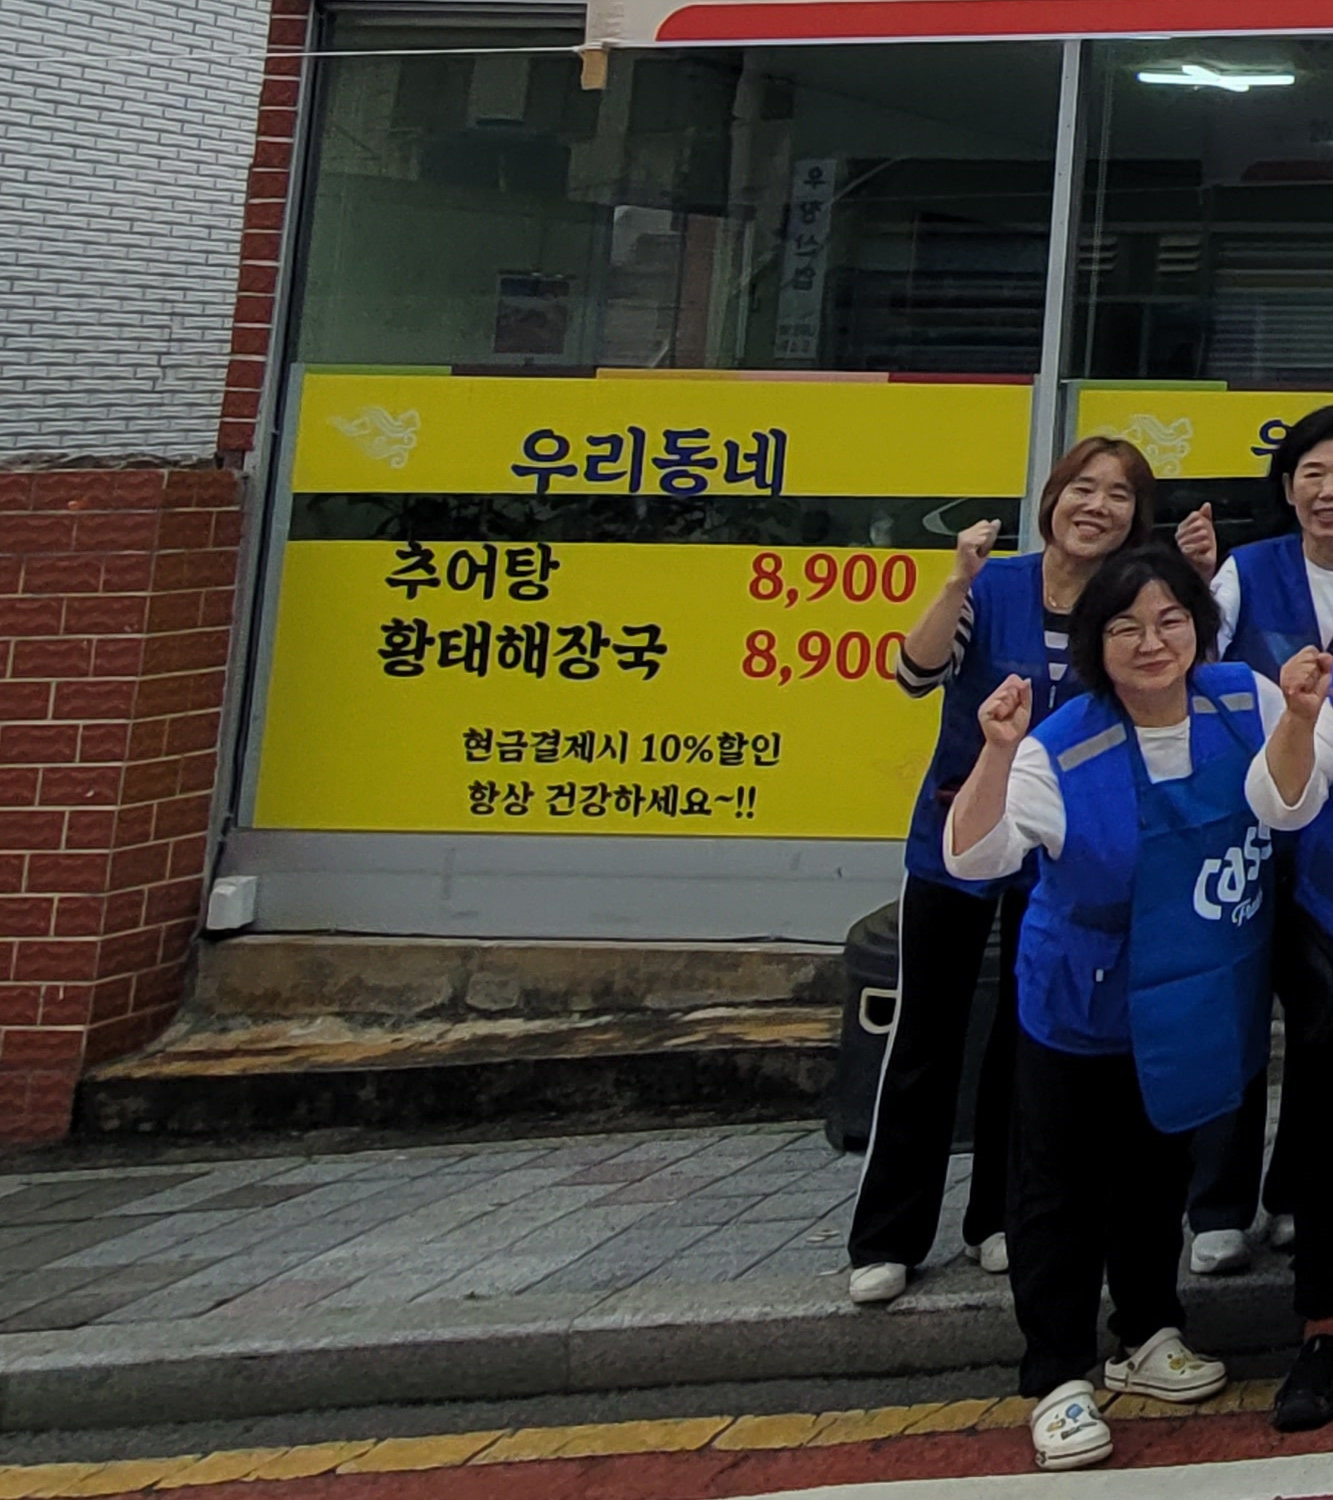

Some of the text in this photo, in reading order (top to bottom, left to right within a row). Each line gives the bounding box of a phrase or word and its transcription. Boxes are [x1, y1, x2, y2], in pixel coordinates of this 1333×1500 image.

[510, 424, 789, 497] 우리동네
[384, 541, 919, 609] 추어탕 8,900
[376, 617, 669, 682] 황태해장국
[461, 727, 784, 770] 현금결제시 10%할인
[467, 779, 758, 823] 항상 건강하세요~!!
